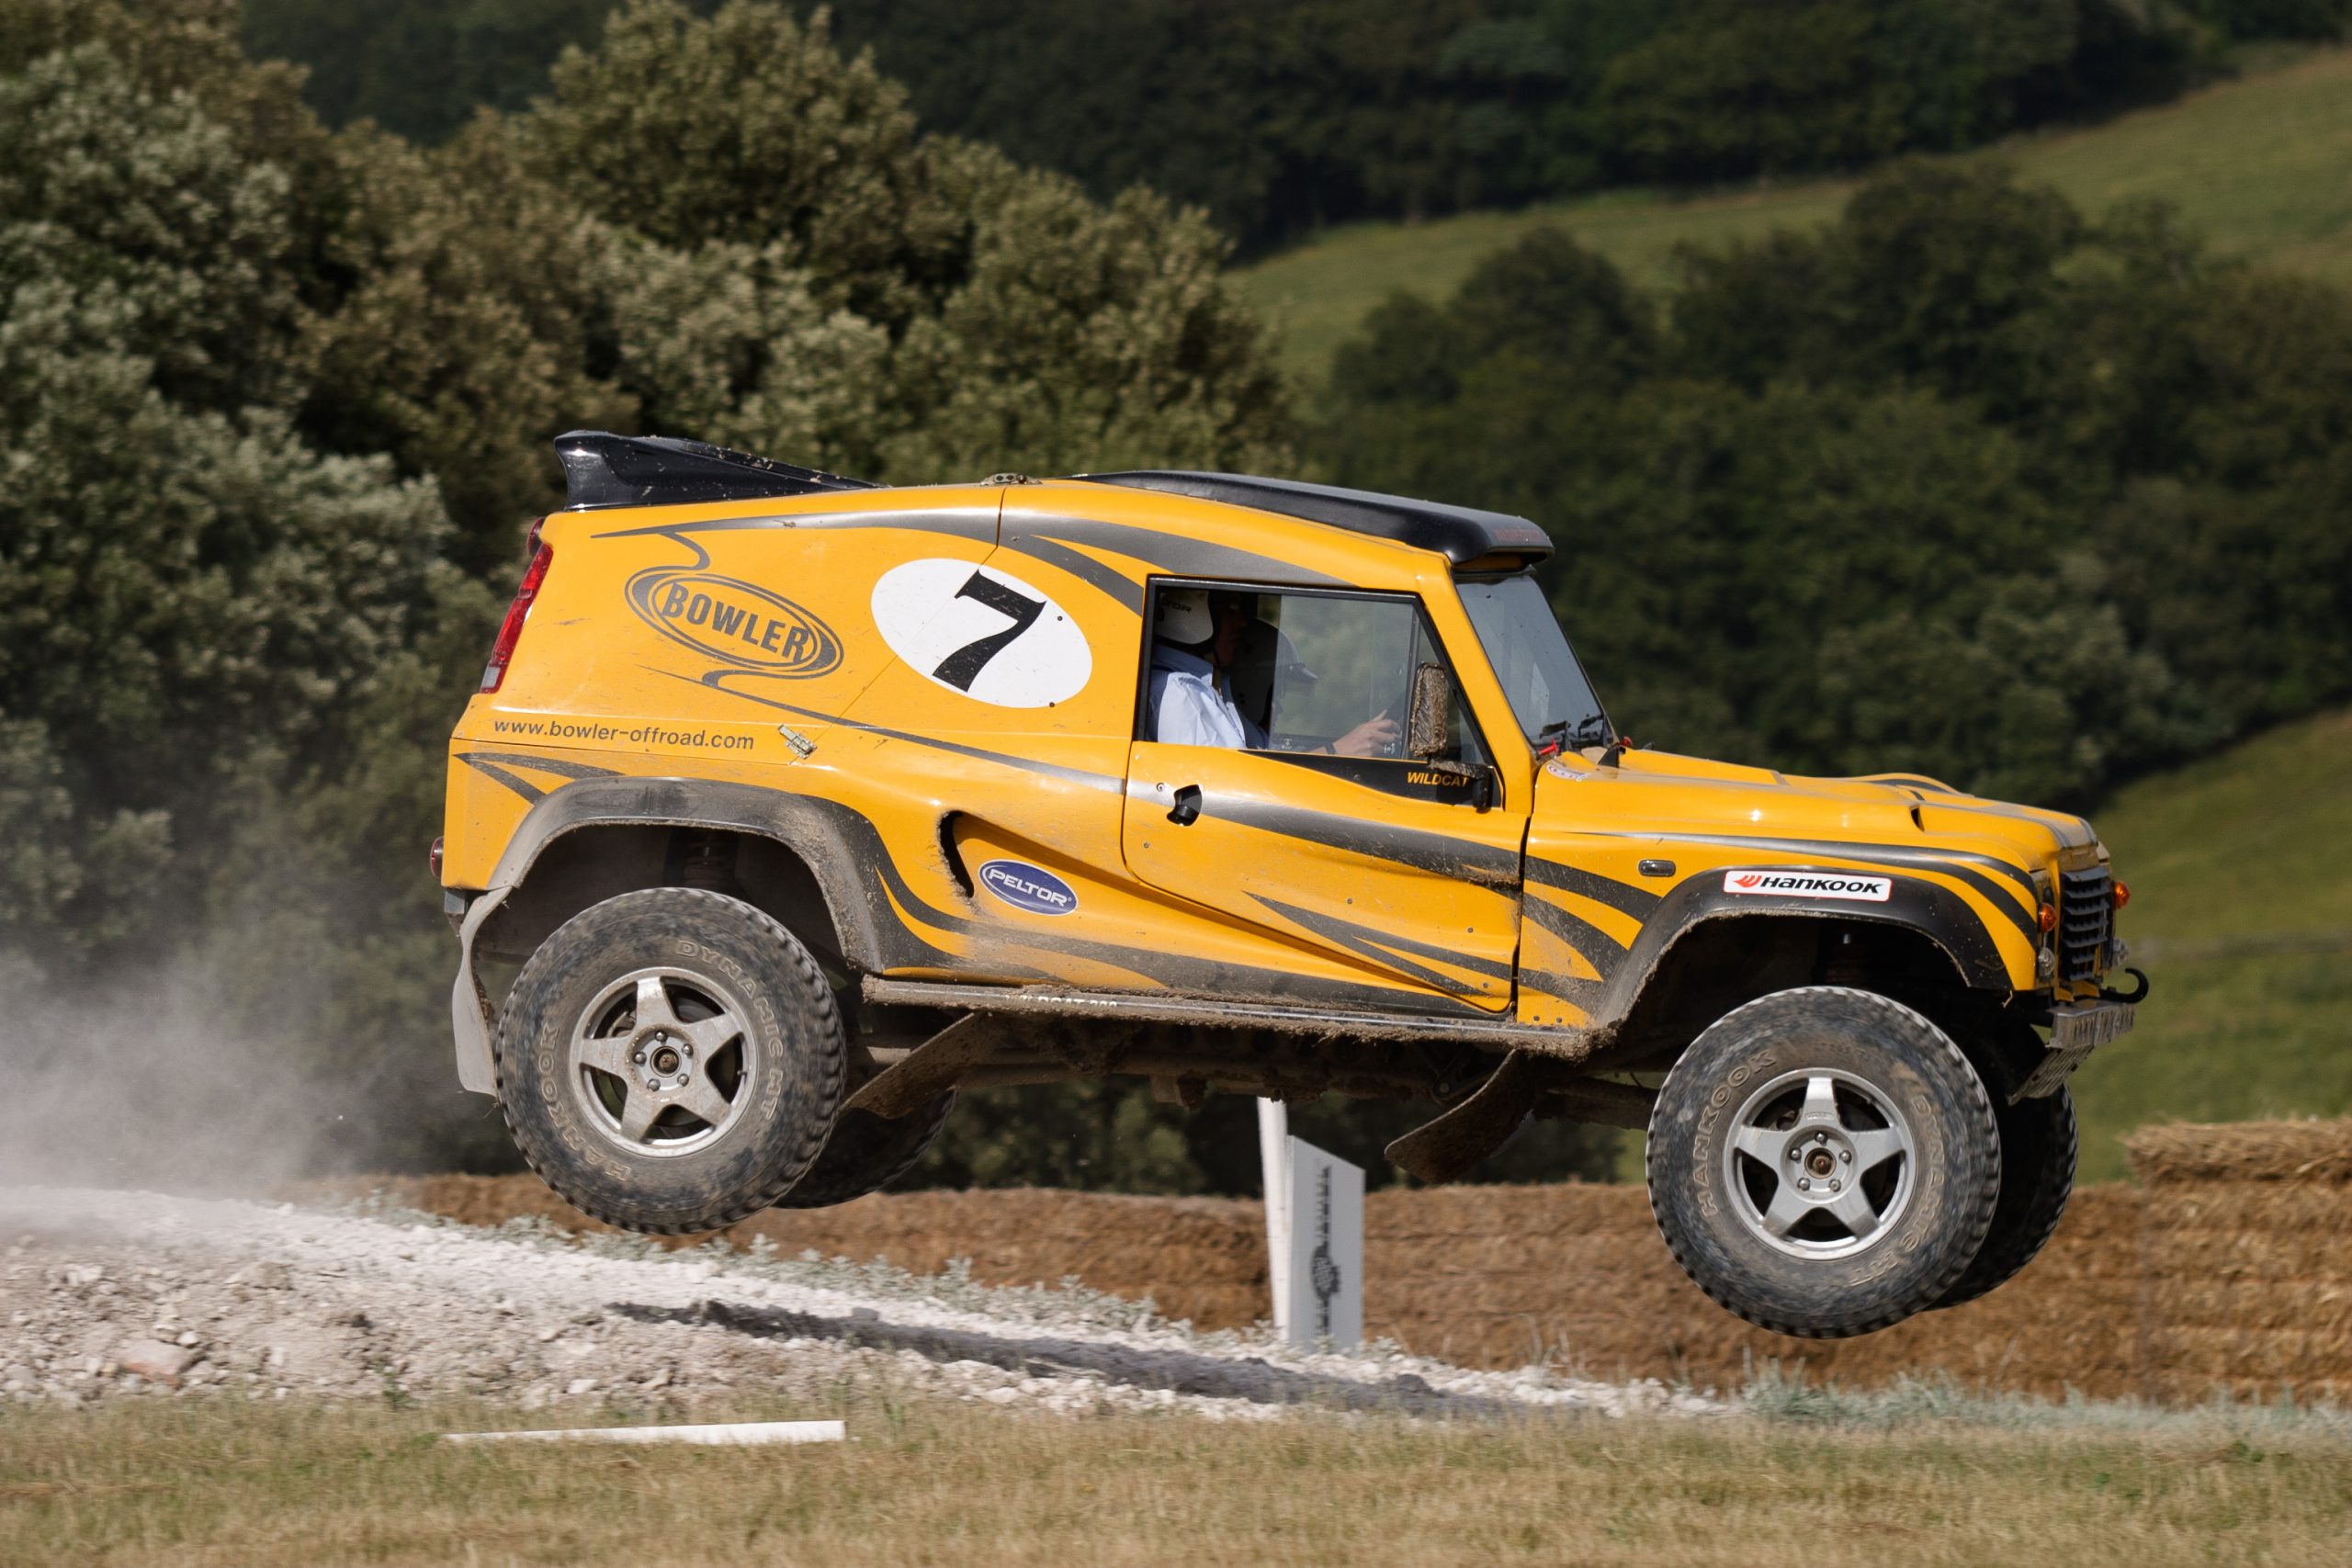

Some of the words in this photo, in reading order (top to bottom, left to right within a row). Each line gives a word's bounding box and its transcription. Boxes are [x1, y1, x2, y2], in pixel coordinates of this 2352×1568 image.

[661, 581, 809, 663] BOWLER
[932, 569, 1046, 693] 7
[493, 720, 754, 750] www.bowler-offroad.com
[1407, 772, 1469, 787] WILDCAT
[989, 868, 1069, 908] PELTOR
[676, 940, 784, 1057] DYNAMIC
[1692, 1050, 1778, 1218] HANKOOK
